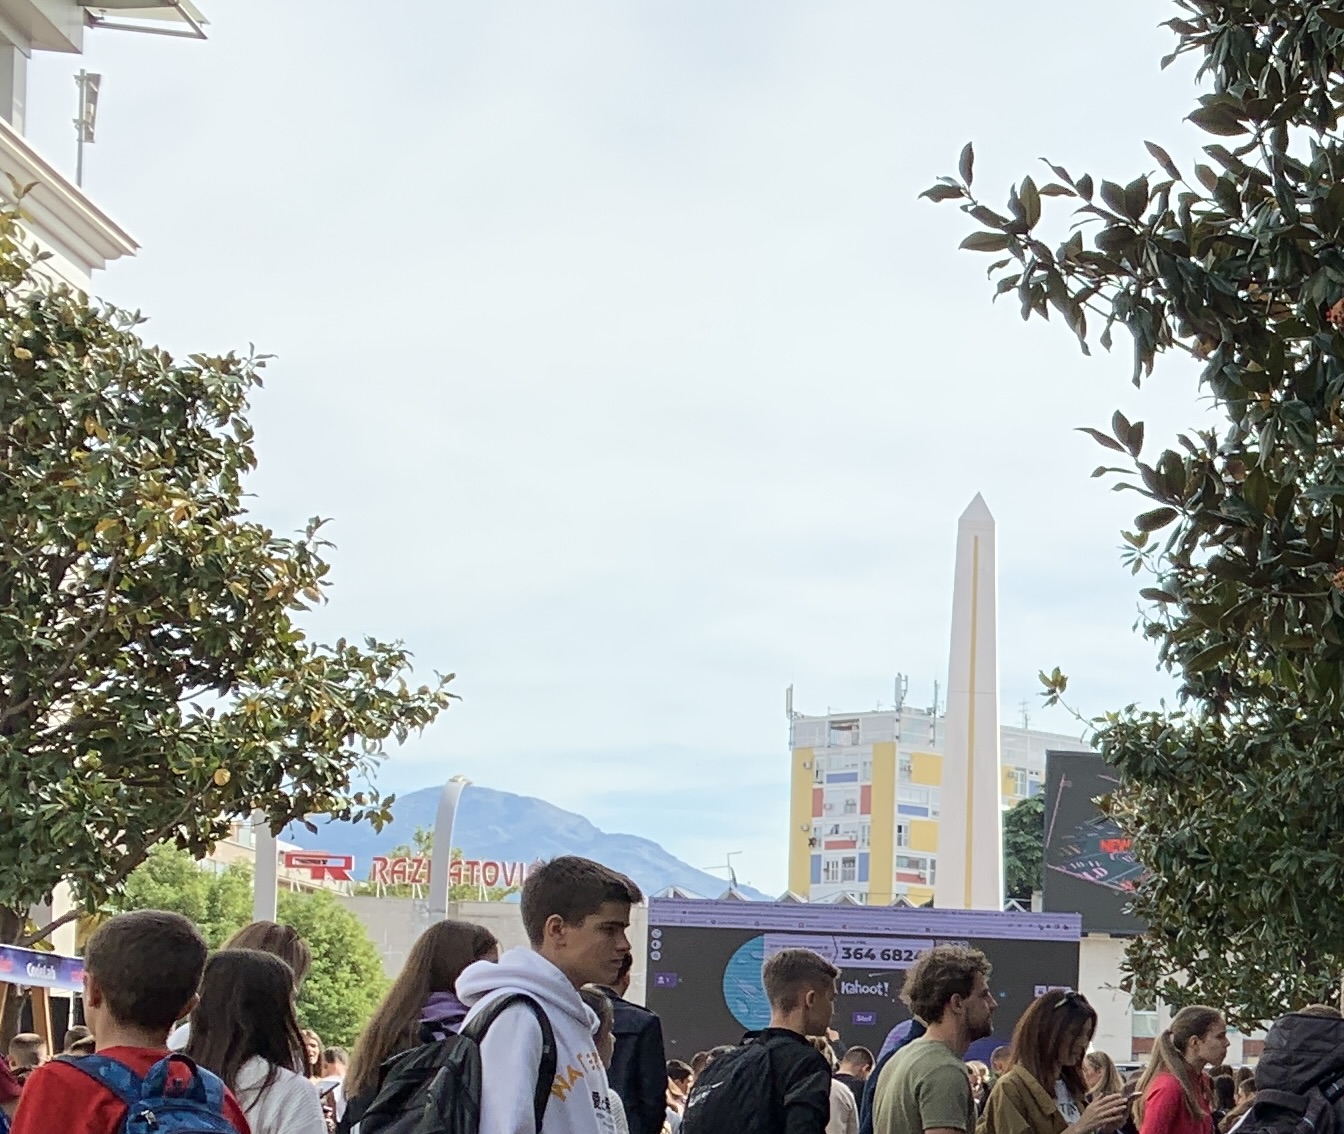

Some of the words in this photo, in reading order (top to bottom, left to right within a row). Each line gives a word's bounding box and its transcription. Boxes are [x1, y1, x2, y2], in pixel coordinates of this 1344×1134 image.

[372, 851, 534, 887] RAŽATOVI
[841, 946, 876, 960] 364
[840, 979, 889, 997] Kahoot!
